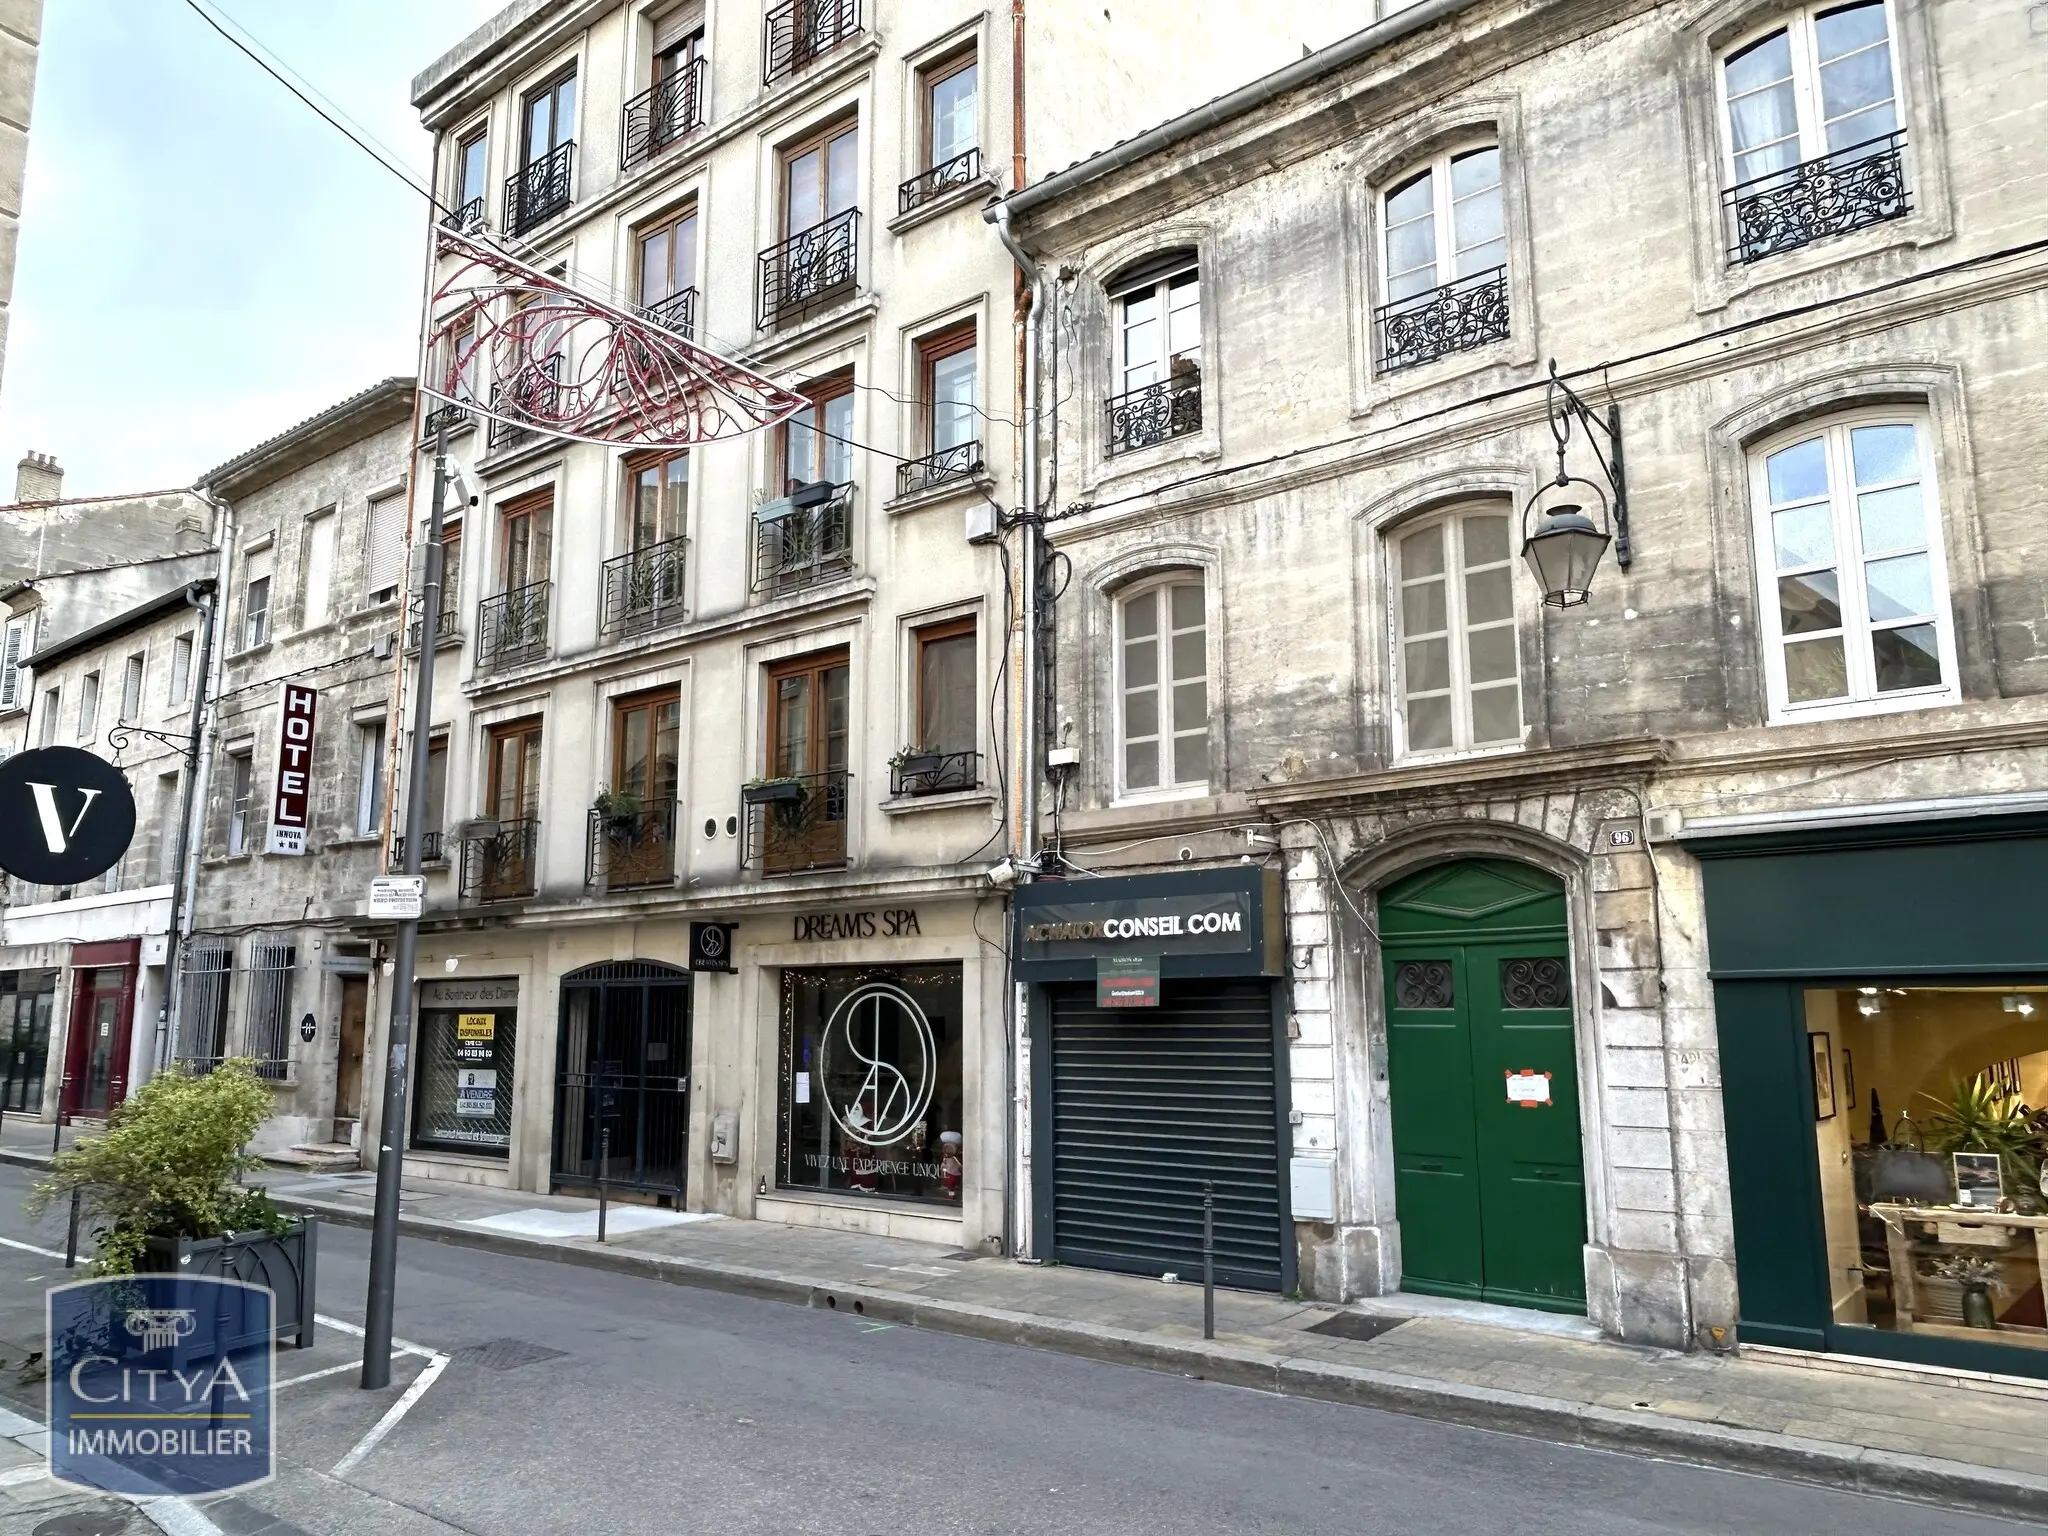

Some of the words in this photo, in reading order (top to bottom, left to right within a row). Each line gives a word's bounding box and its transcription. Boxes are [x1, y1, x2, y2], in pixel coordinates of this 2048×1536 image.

[279, 690, 312, 822] HOTEL
[25, 782, 102, 853] V
[1615, 832, 1630, 844] 96
[882, 909, 921, 937] SPA
